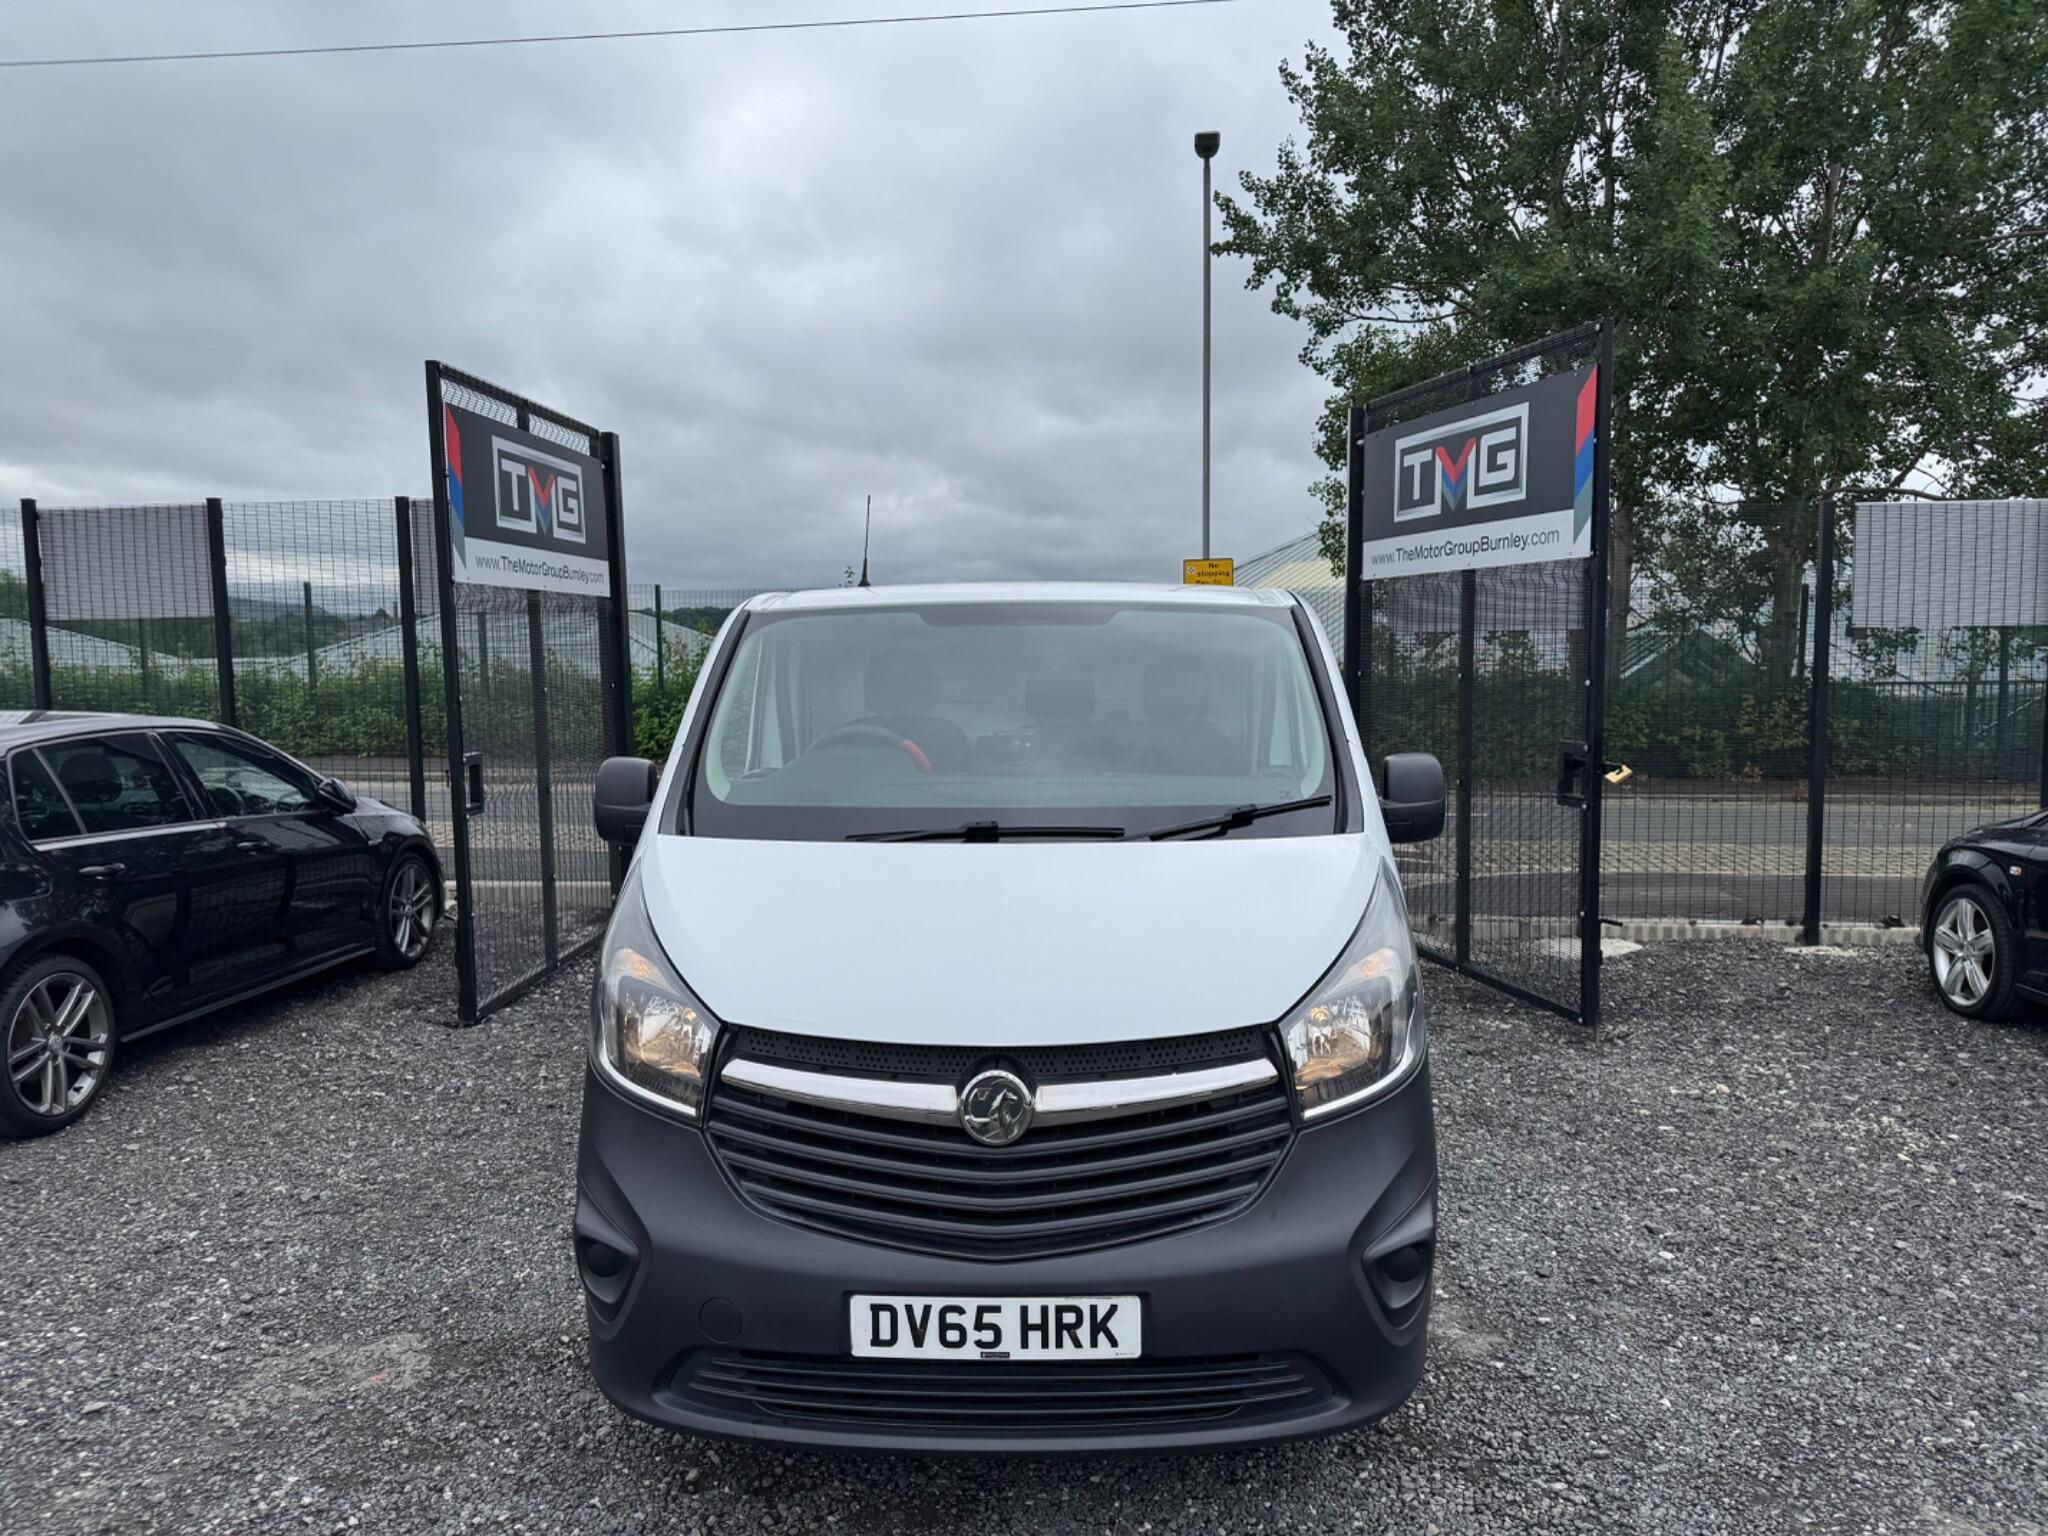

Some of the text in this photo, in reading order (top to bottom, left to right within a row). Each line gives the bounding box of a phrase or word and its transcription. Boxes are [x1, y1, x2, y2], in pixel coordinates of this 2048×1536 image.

[1402, 424, 1518, 512] TMG
[500, 456, 580, 537] TMG
[475, 555, 604, 584] www.TheMotorGroupBurnley.com
[1371, 528, 1560, 565] www.TheMotorGroupBurnley.com
[870, 1303, 1119, 1349] DV65 HRK
